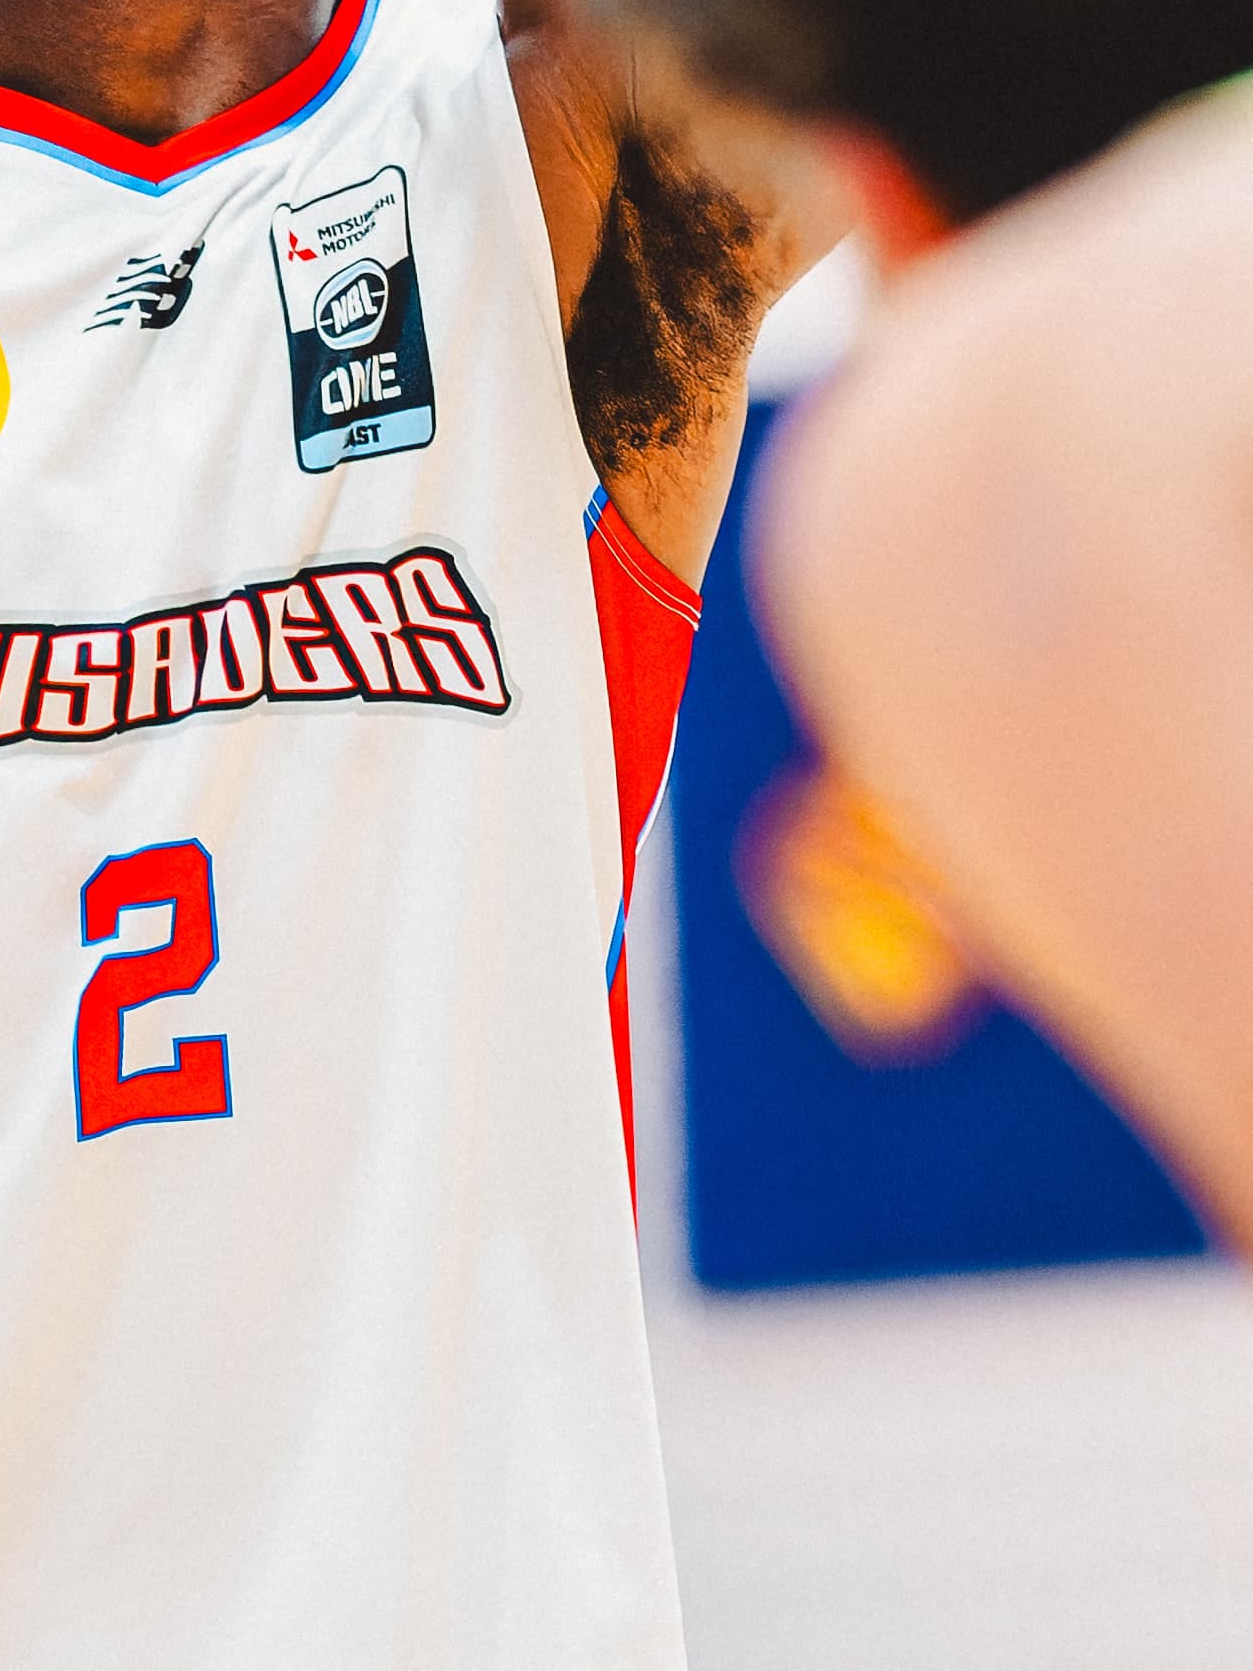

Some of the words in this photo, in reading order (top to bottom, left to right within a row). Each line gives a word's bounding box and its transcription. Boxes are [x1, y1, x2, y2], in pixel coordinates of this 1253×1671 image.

[331, 278, 378, 335] NBL
[320, 351, 402, 415] ONE
[73, 837, 233, 1142] 2
